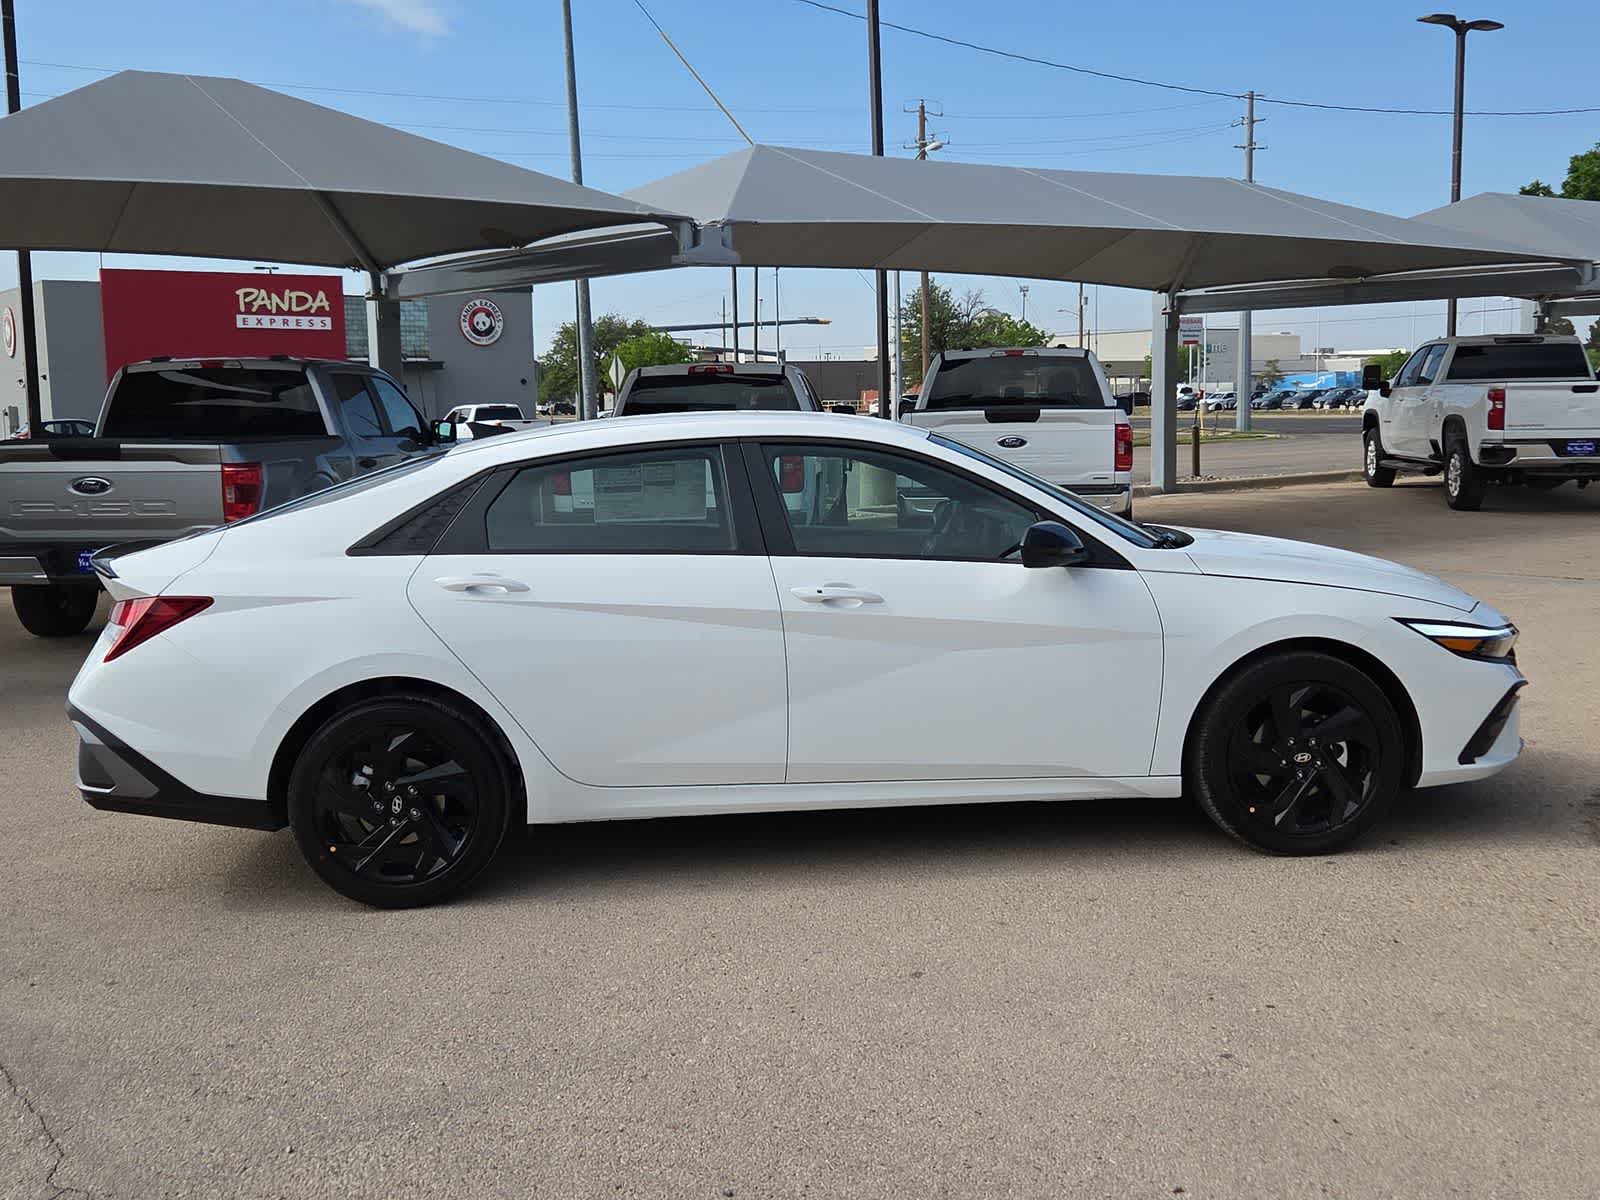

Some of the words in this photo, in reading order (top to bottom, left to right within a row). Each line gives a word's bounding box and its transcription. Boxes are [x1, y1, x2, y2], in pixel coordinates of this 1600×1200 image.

[235, 287, 330, 314] PANDA
[463, 302, 478, 323] PANDA
[480, 300, 502, 323] EXPRESS
[242, 317, 327, 328] EXPRESS
[9, 499, 177, 518] F-150
